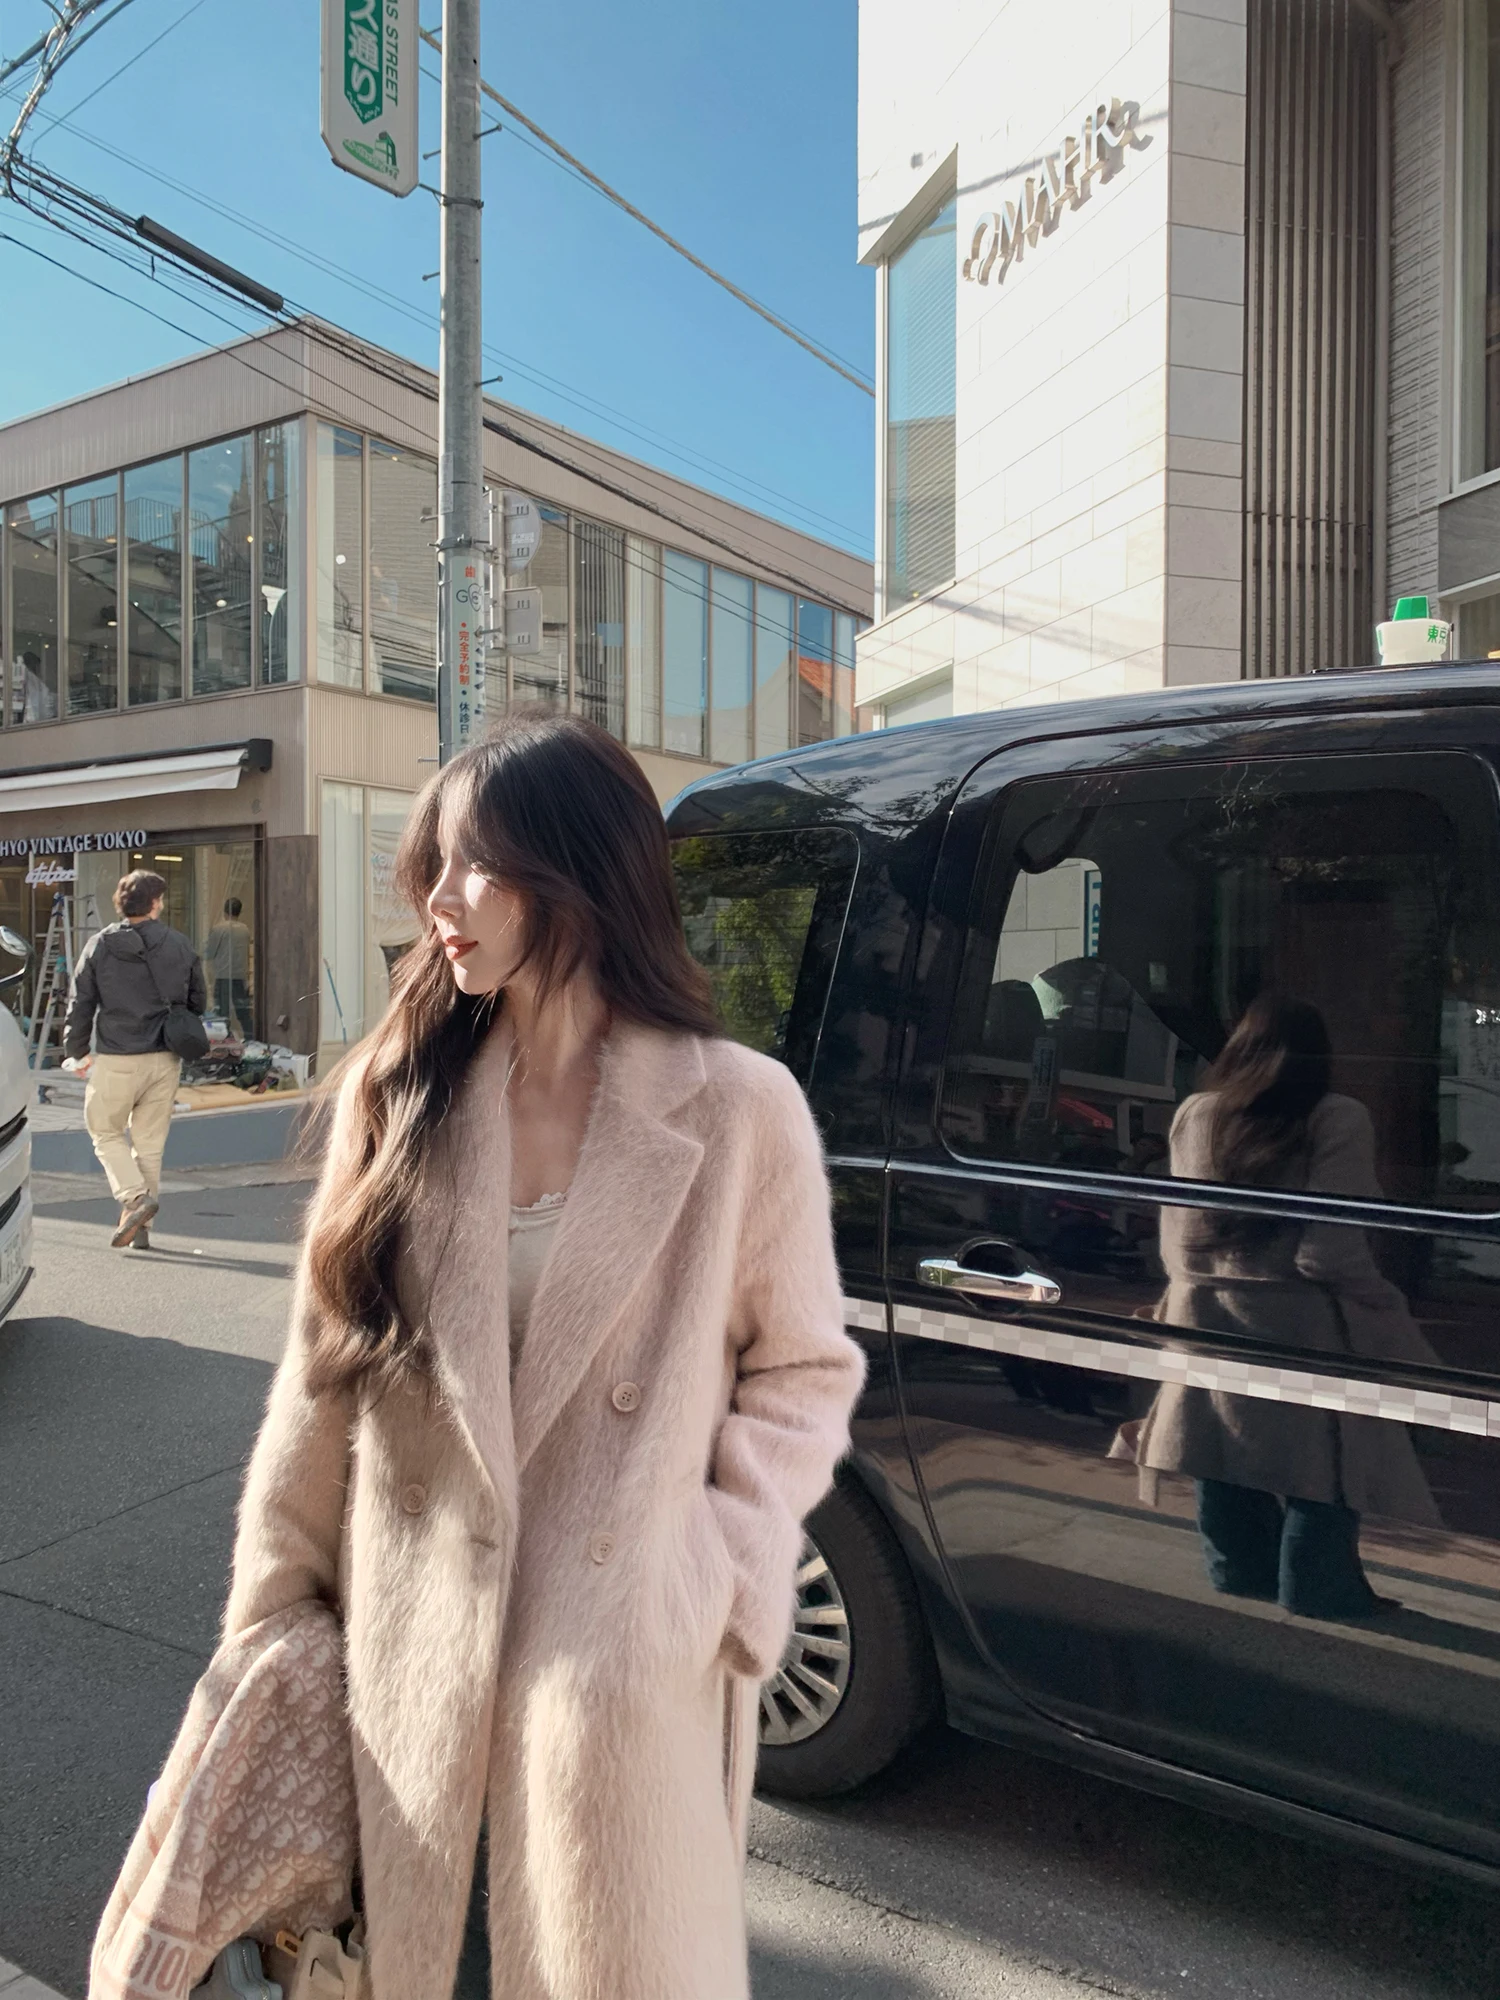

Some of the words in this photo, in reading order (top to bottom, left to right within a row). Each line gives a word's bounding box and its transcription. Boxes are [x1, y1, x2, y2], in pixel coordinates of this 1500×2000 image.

[385, 25, 399, 107] STREET
[459, 701, 470, 734] 休診日
[30, 834, 92, 854] VINTAGE
[95, 830, 147, 849] TOKYO
